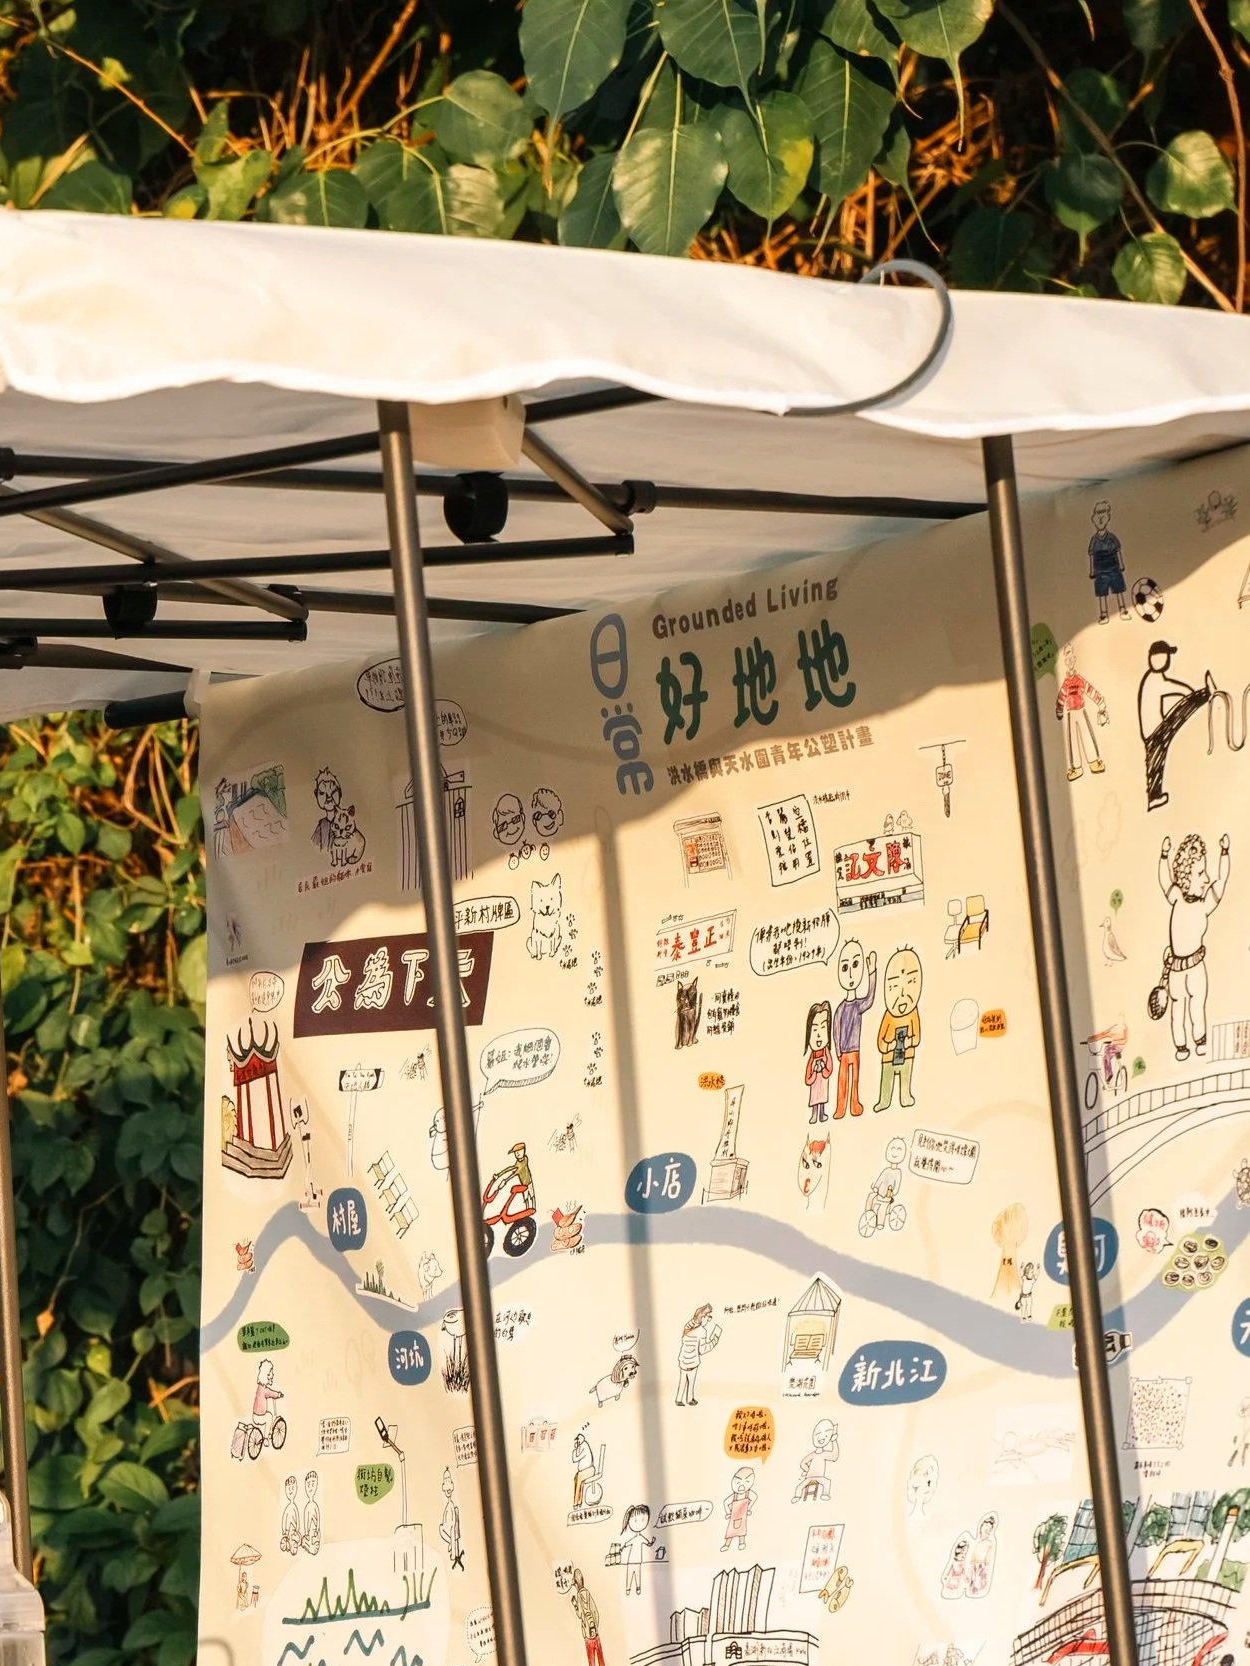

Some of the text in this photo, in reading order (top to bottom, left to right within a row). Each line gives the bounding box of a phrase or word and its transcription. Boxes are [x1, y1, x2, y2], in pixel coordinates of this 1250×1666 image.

[652, 576, 839, 640] Grounded Living
[655, 619, 856, 745] 好地地
[590, 613, 654, 795] 日常
[636, 1157, 681, 1199] 小店
[332, 1199, 362, 1236] 村屋
[394, 1339, 425, 1370] 河坑
[851, 1355, 937, 1393] 新北江
